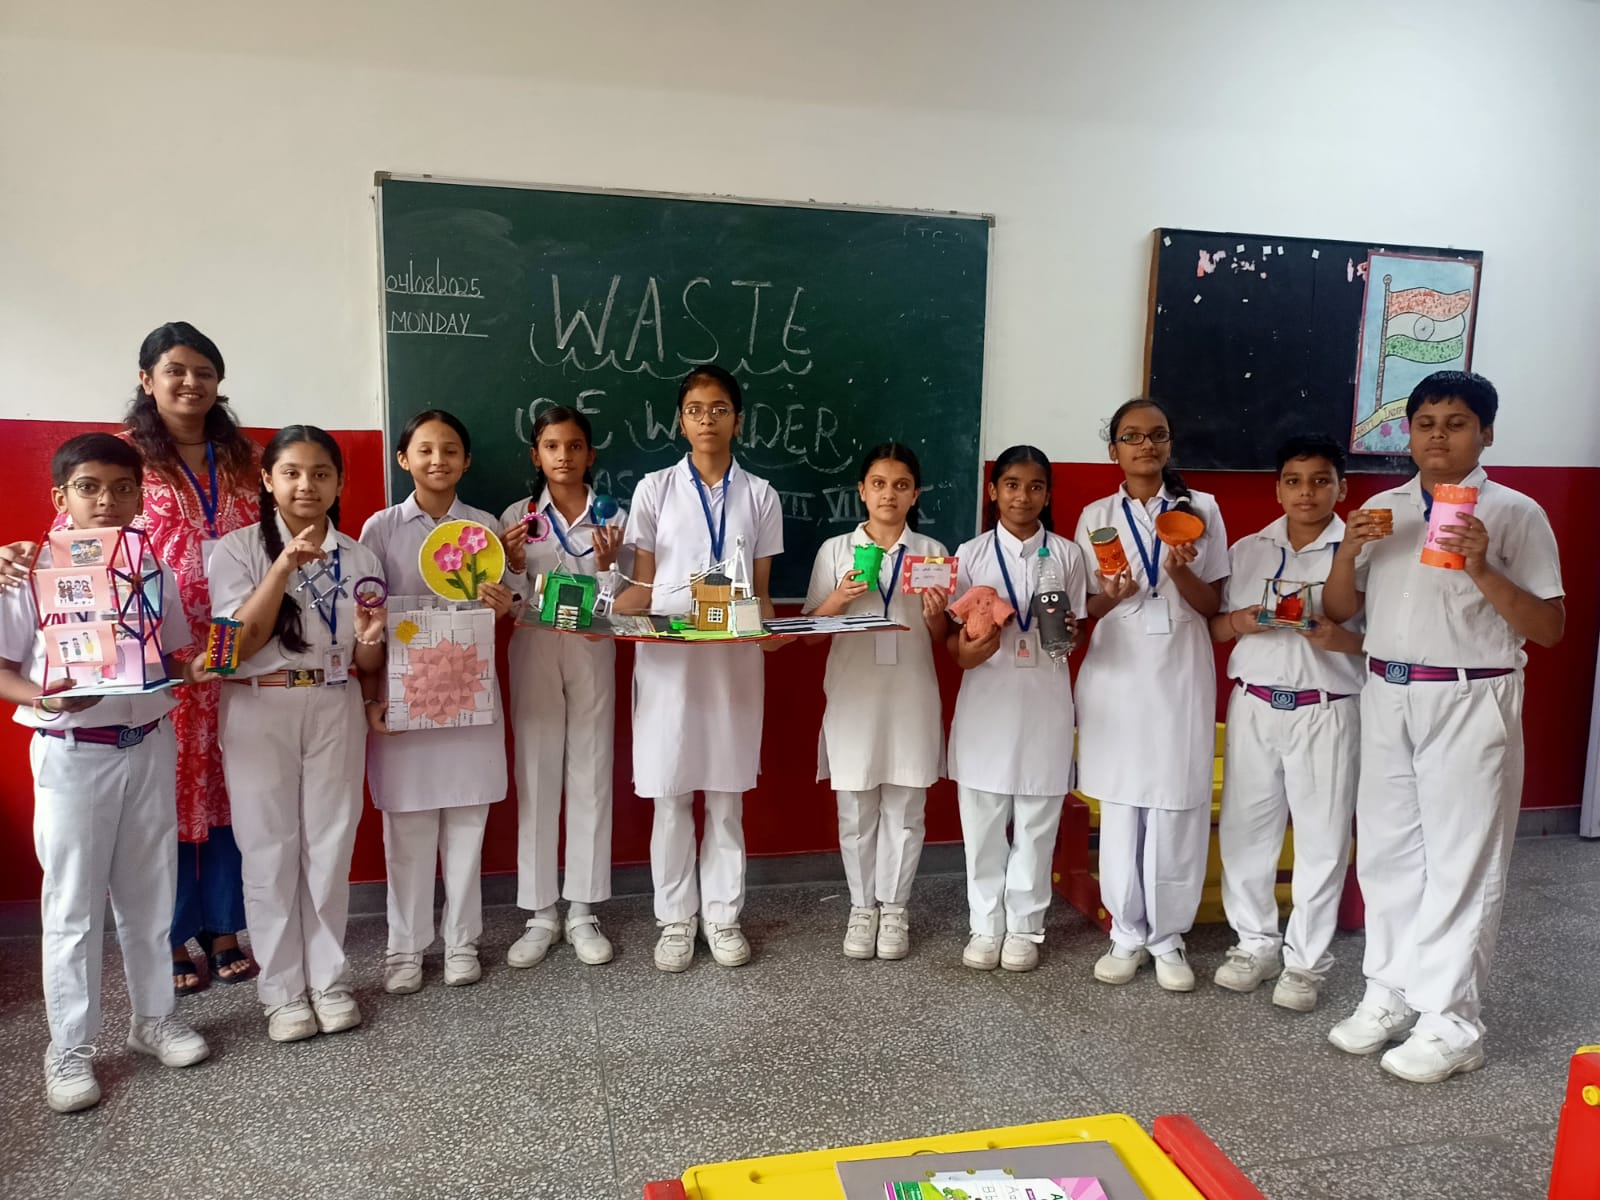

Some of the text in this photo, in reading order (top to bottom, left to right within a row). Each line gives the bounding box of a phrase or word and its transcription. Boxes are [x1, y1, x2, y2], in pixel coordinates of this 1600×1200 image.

[391, 311, 471, 335] MONDAY
[551, 273, 811, 364] WASTE
[644, 399, 842, 458] WDER
